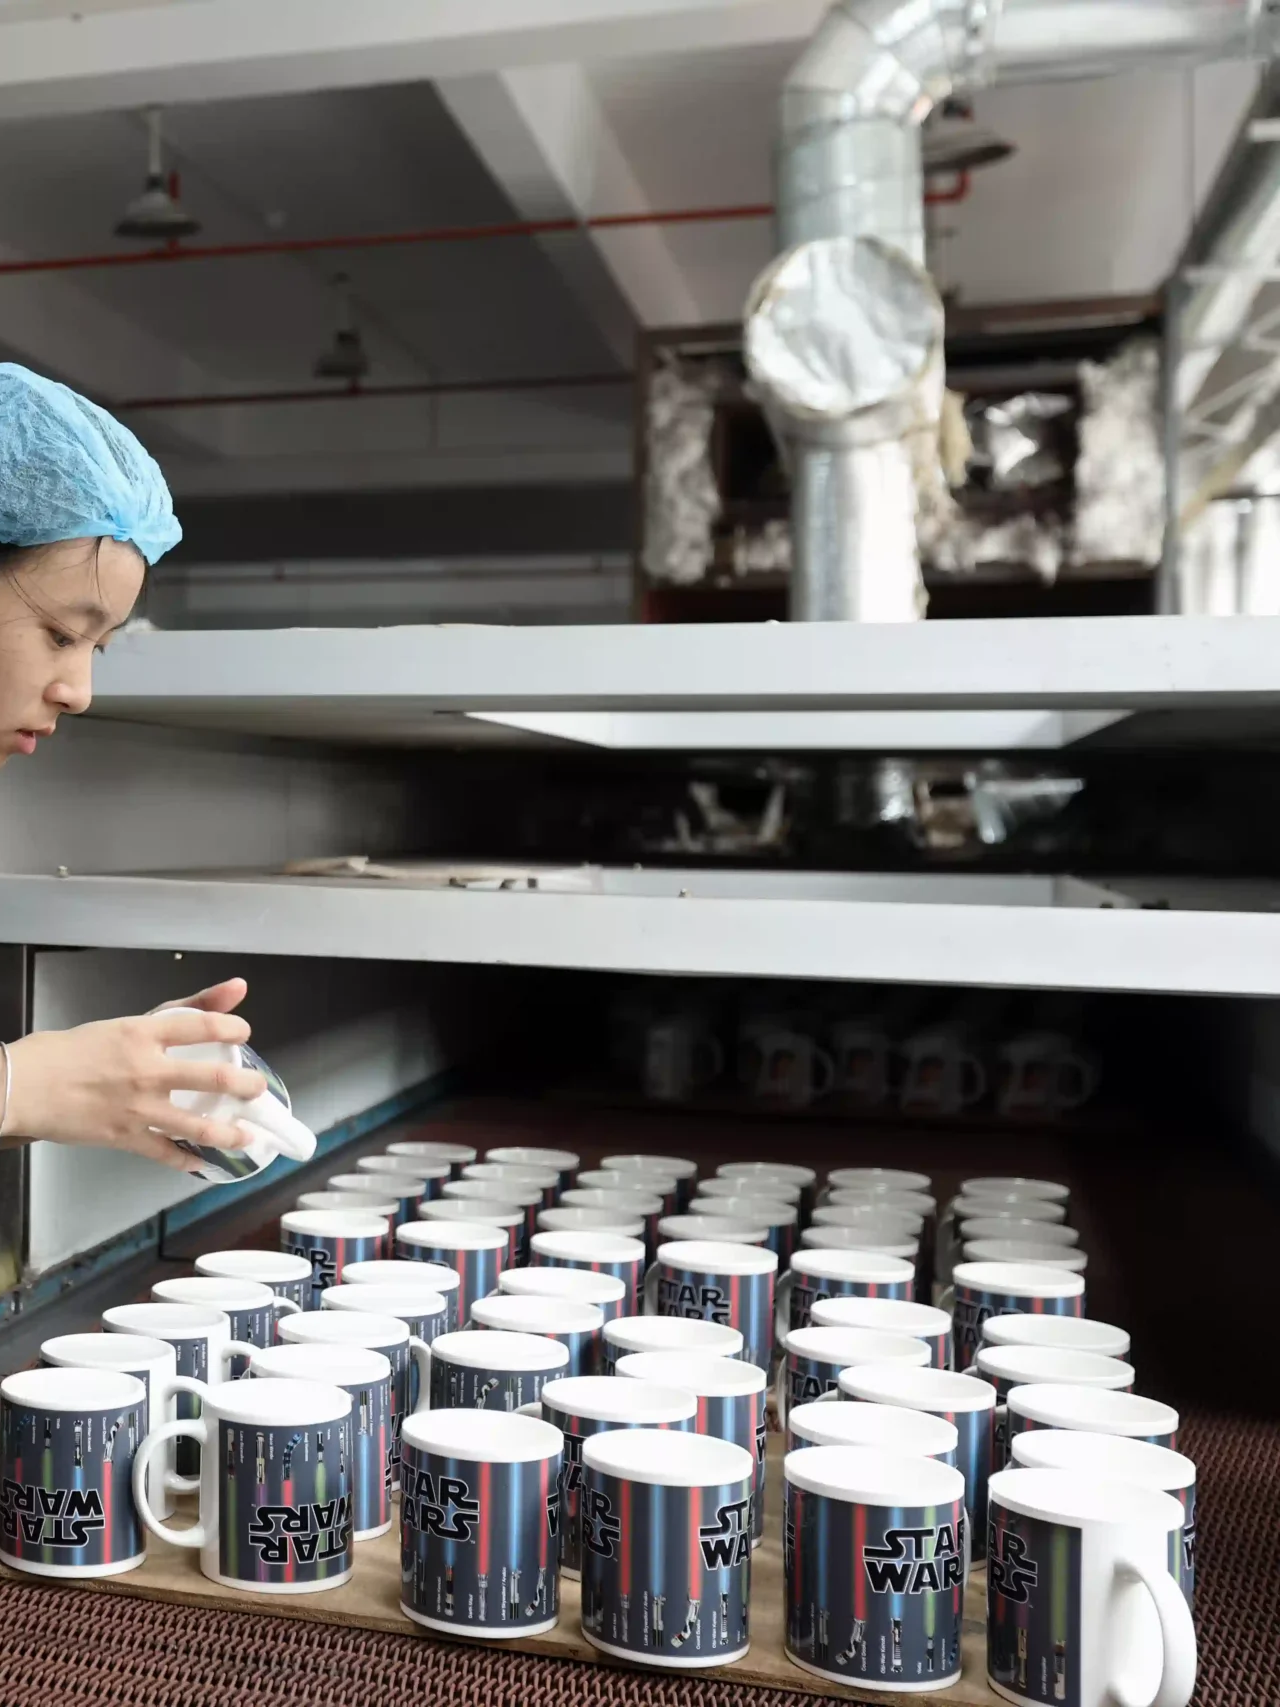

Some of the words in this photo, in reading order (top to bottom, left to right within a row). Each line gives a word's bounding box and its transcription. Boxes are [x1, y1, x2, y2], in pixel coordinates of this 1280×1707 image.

[658, 1279, 732, 1309] TAR
[400, 1457, 480, 1512] TAR
[0, 1506, 106, 1548] STAR
[402, 1494, 480, 1542] ARS
[698, 1530, 754, 1571] WA
[863, 1554, 964, 1595] WAR
[988, 1555, 1038, 1605] RS
